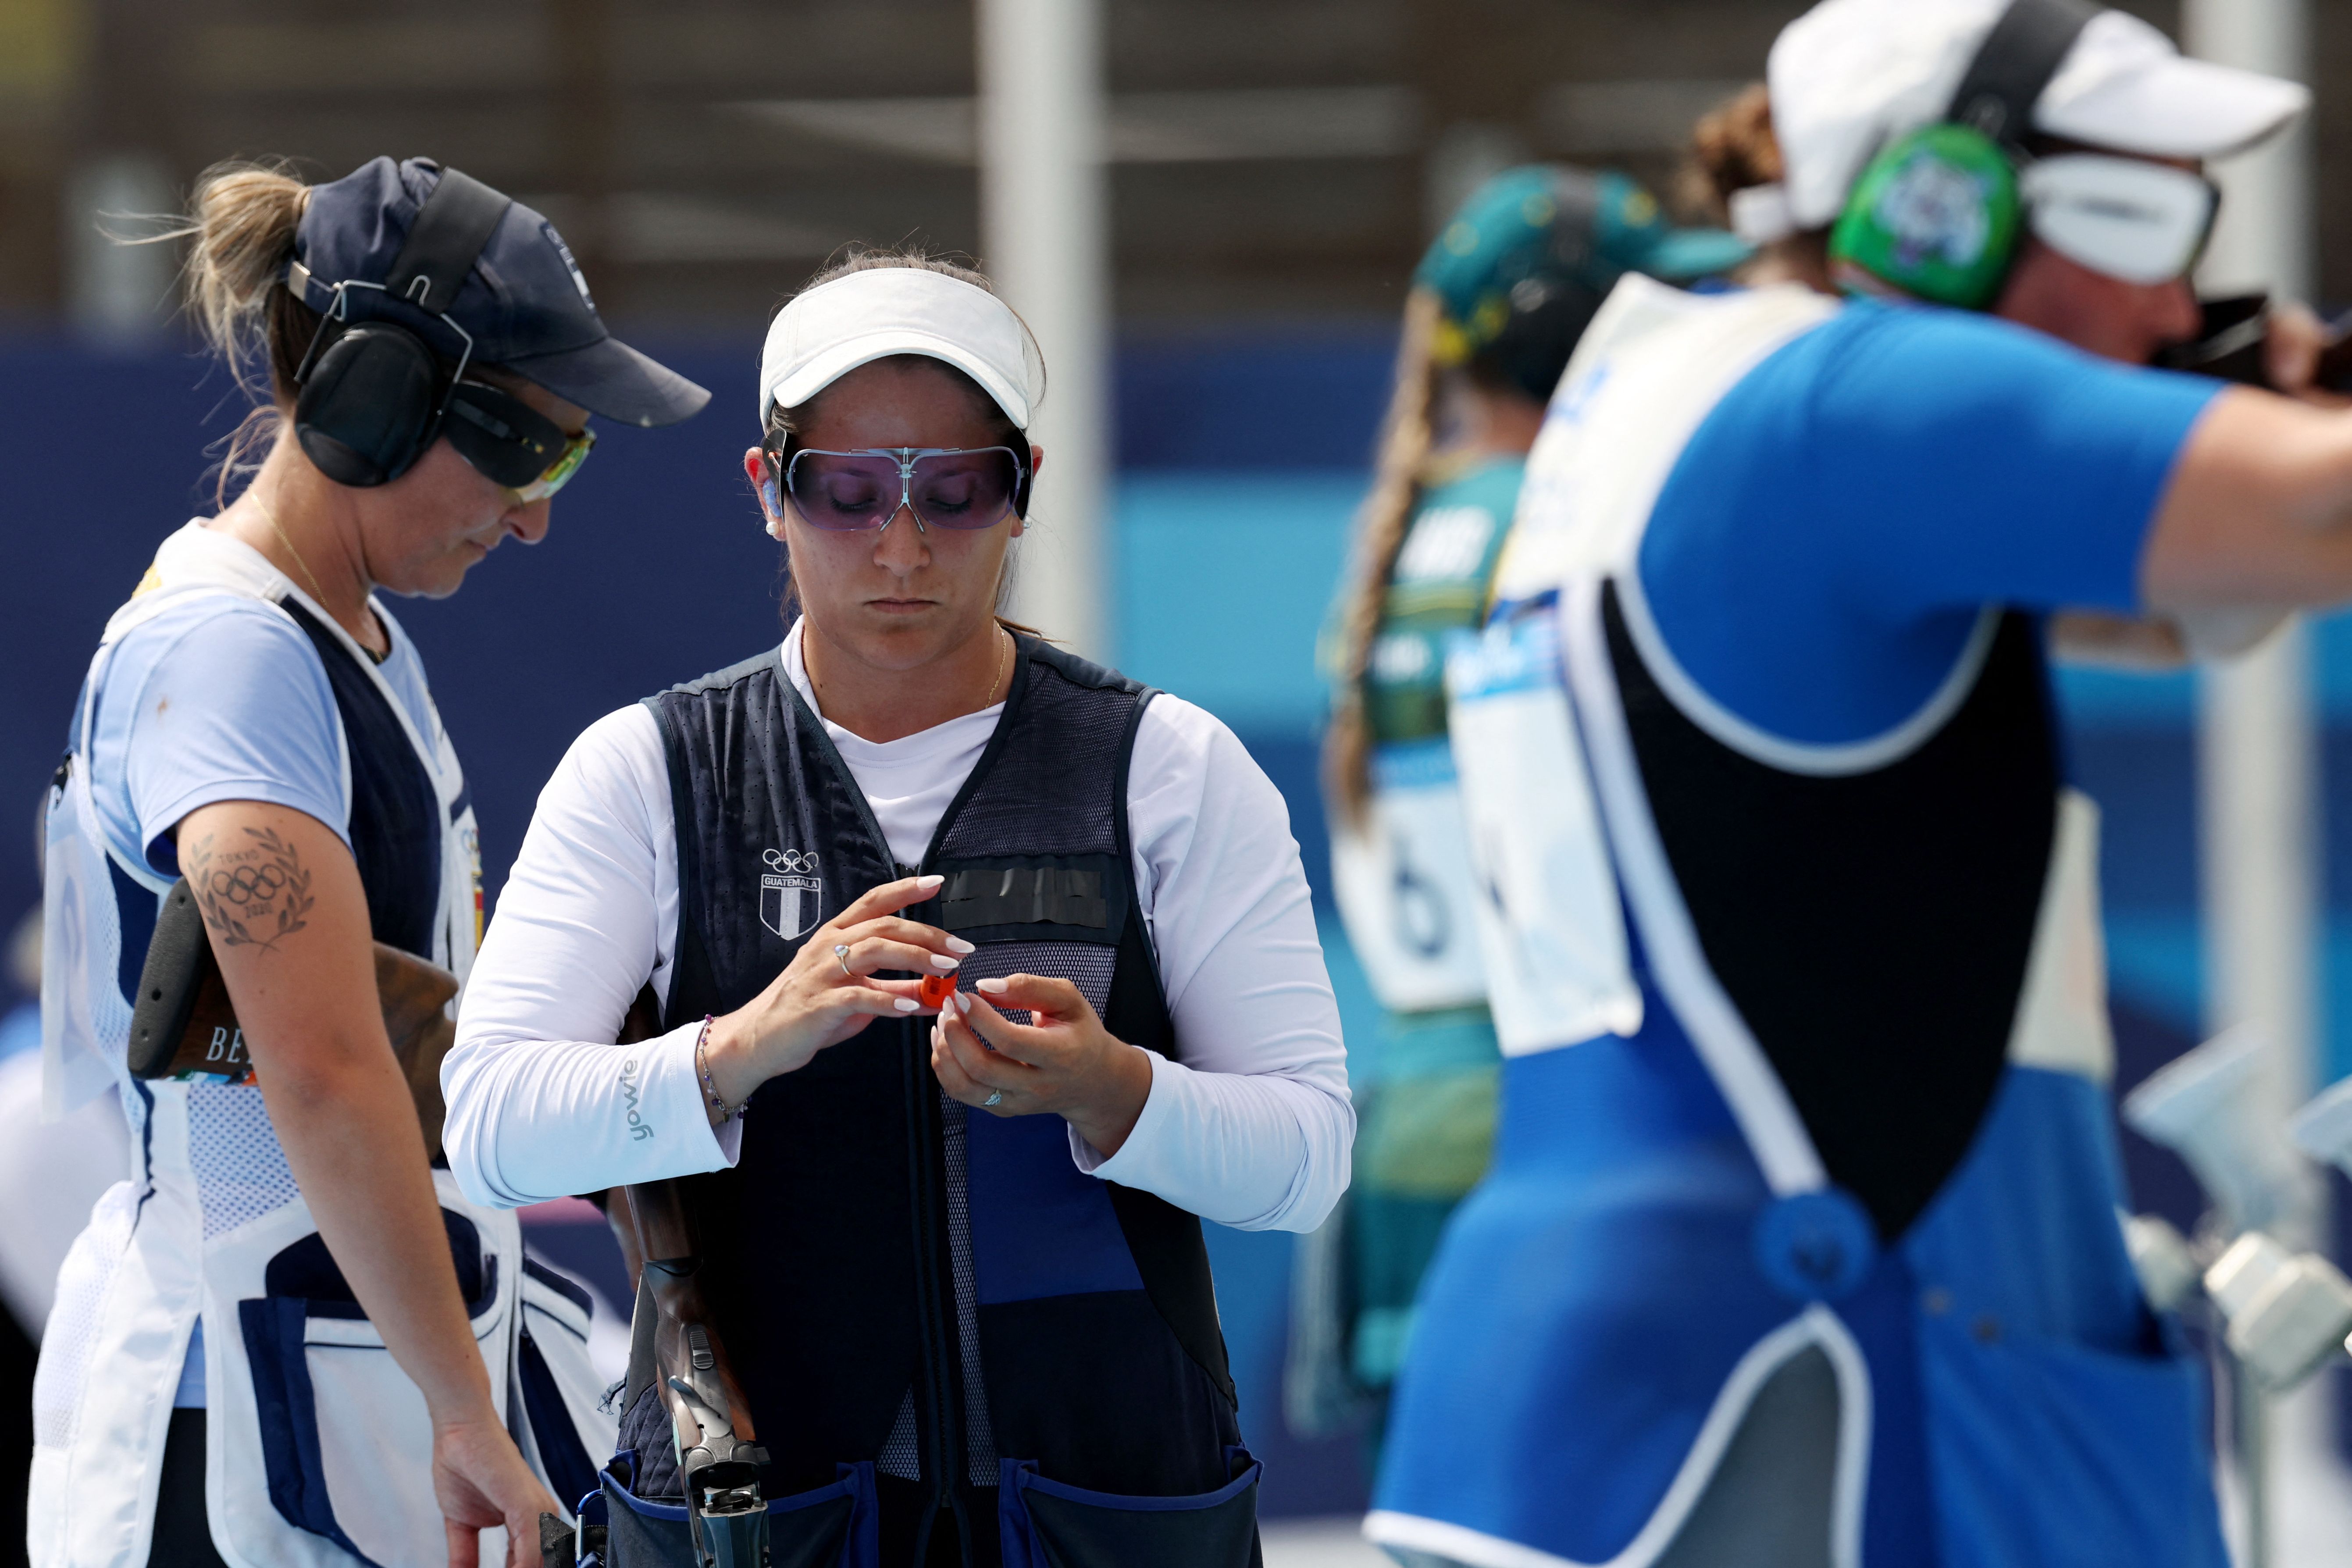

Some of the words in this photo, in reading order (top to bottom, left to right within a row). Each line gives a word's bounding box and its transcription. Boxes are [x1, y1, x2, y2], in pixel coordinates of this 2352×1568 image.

[764, 877, 818, 888] GUATEMALA
[205, 1026, 253, 1065] BE
[619, 1060, 654, 1141] yowie
